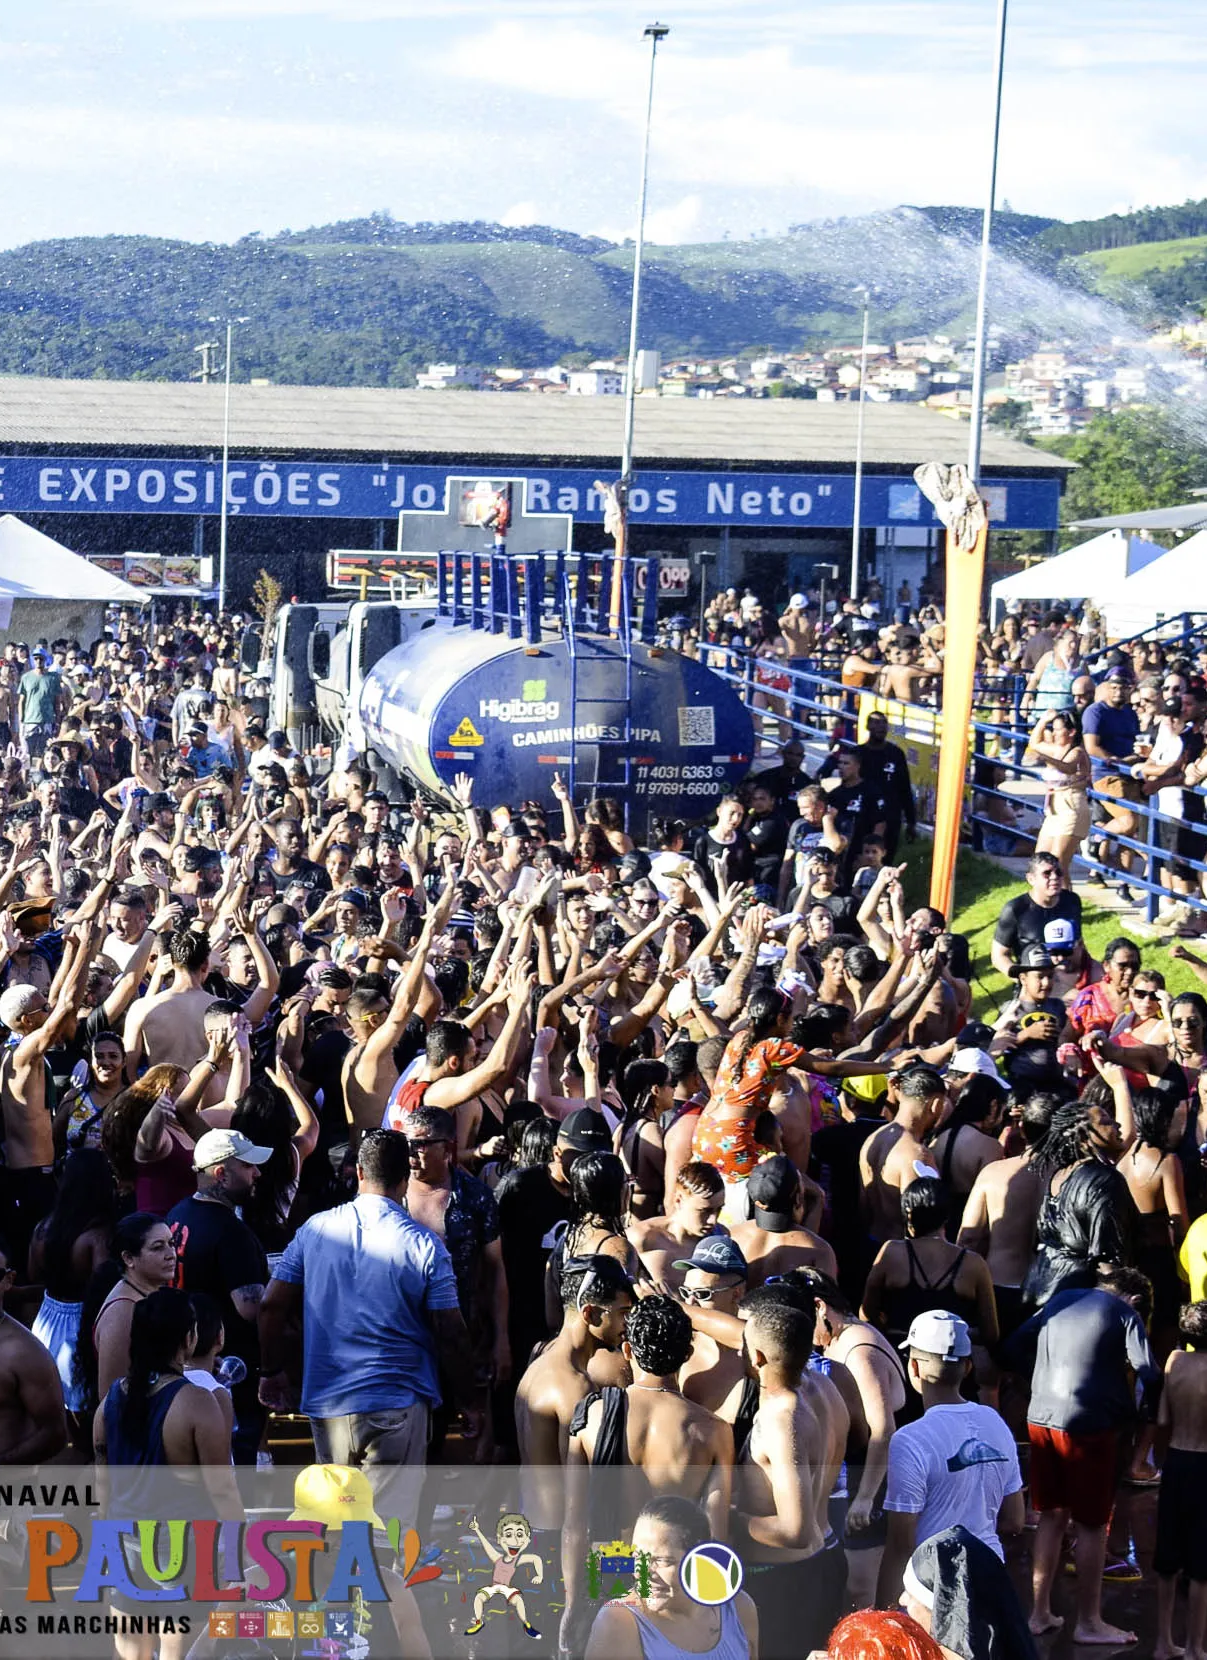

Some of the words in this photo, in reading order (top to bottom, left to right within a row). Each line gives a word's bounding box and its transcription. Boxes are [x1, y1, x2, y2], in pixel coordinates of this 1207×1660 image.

[38, 463, 341, 515] EXPOSIÇÕES
[706, 482, 832, 516] Neto"
[479, 698, 560, 722] Higibrag
[512, 723, 620, 747] CAMINHÕES
[637, 766, 648, 778] 11
[650, 765, 679, 779] 4031
[681, 765, 713, 779] 6363
[635, 782, 646, 794] 11
[648, 782, 719, 795] 97691-6600
